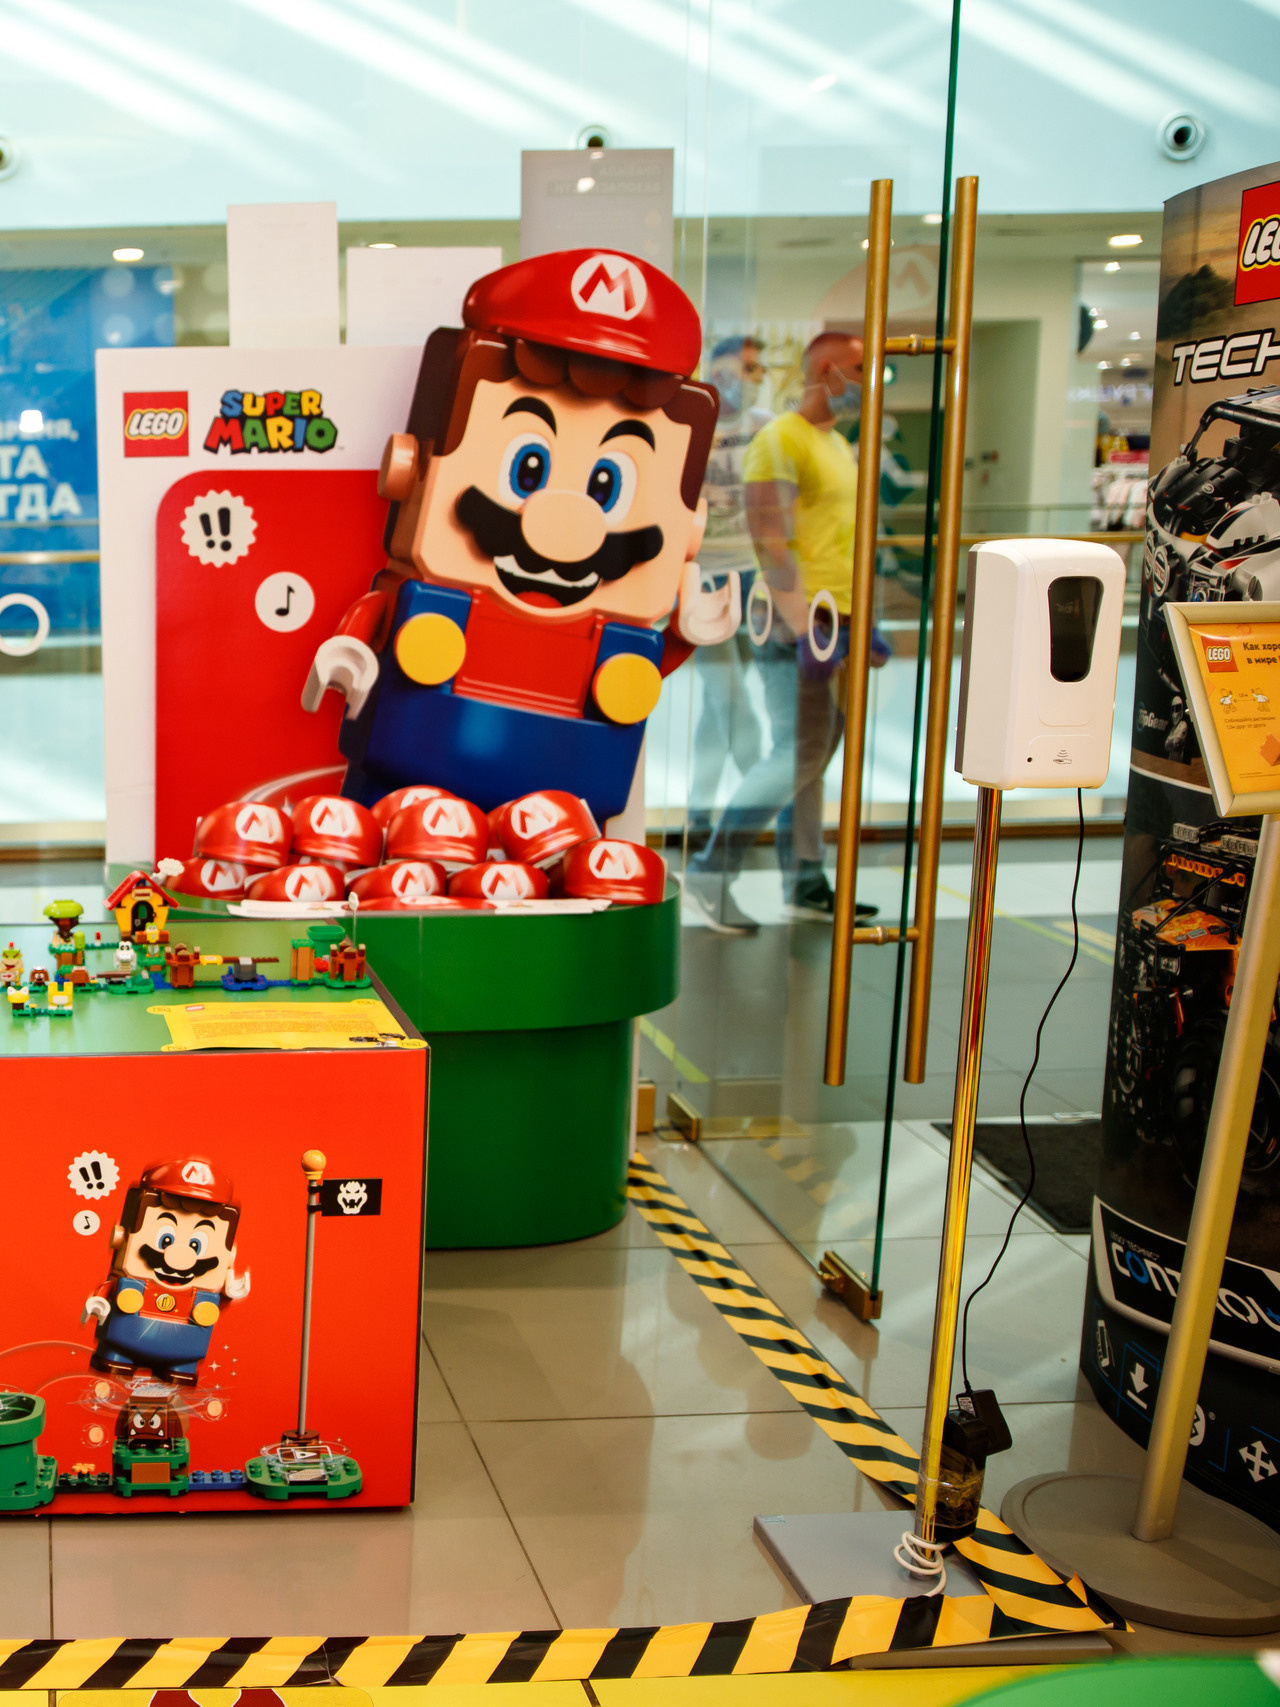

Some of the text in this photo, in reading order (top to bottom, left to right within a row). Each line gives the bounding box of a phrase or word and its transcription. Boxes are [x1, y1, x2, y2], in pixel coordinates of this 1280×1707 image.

[1242, 216, 1280, 270] LE
[220, 389, 323, 419] SUPER
[126, 408, 187, 438] LEGO
[203, 414, 338, 454] MARIO
[1208, 646, 1231, 662] LEGO
[1243, 642, 1261, 651] Как
[1255, 655, 1277, 665] мире
